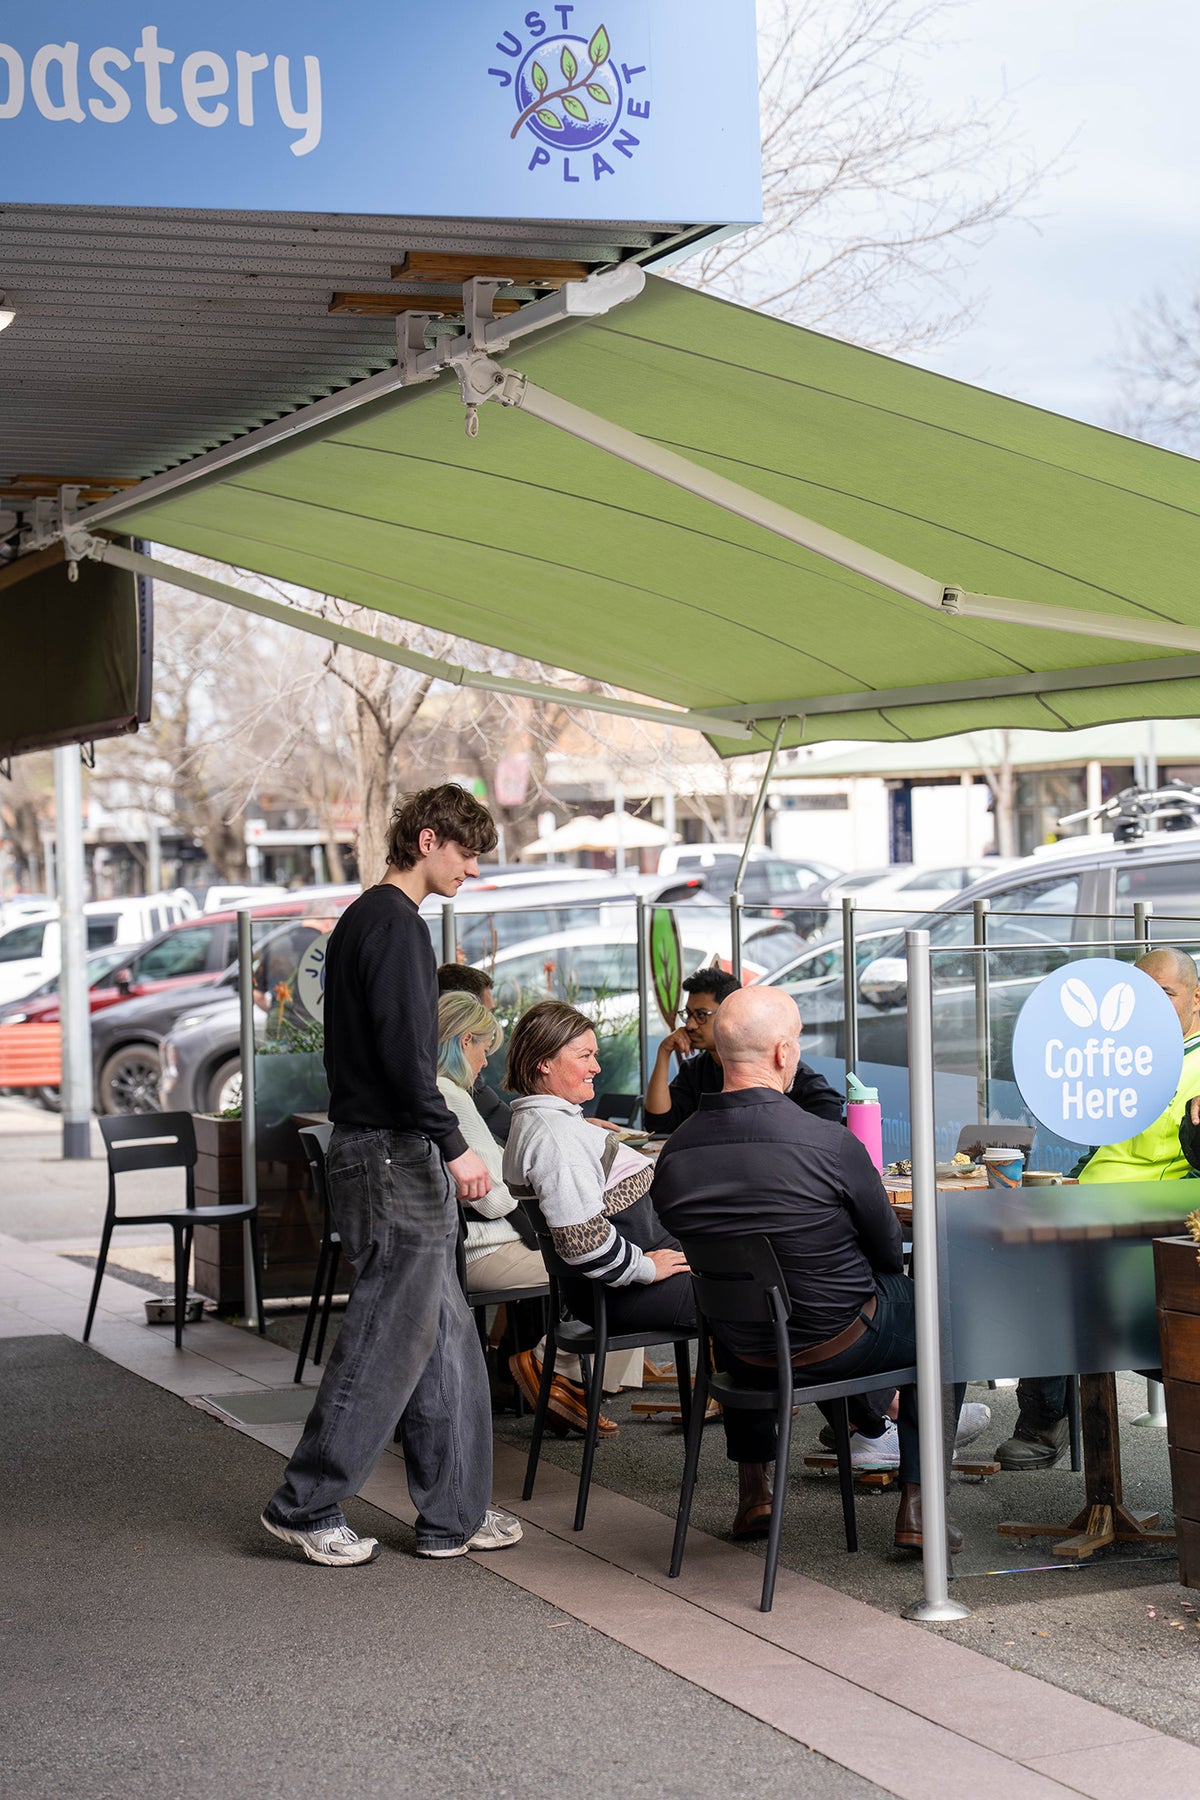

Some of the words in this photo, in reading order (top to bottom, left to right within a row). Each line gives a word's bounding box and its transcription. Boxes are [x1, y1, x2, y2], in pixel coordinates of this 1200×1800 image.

[487, 5, 574, 87] JUST
[528, 63, 650, 182] PLANET
[305, 948, 325, 978] JU
[1045, 1037, 1153, 1079] Coffee
[1062, 1081, 1138, 1120] Here
